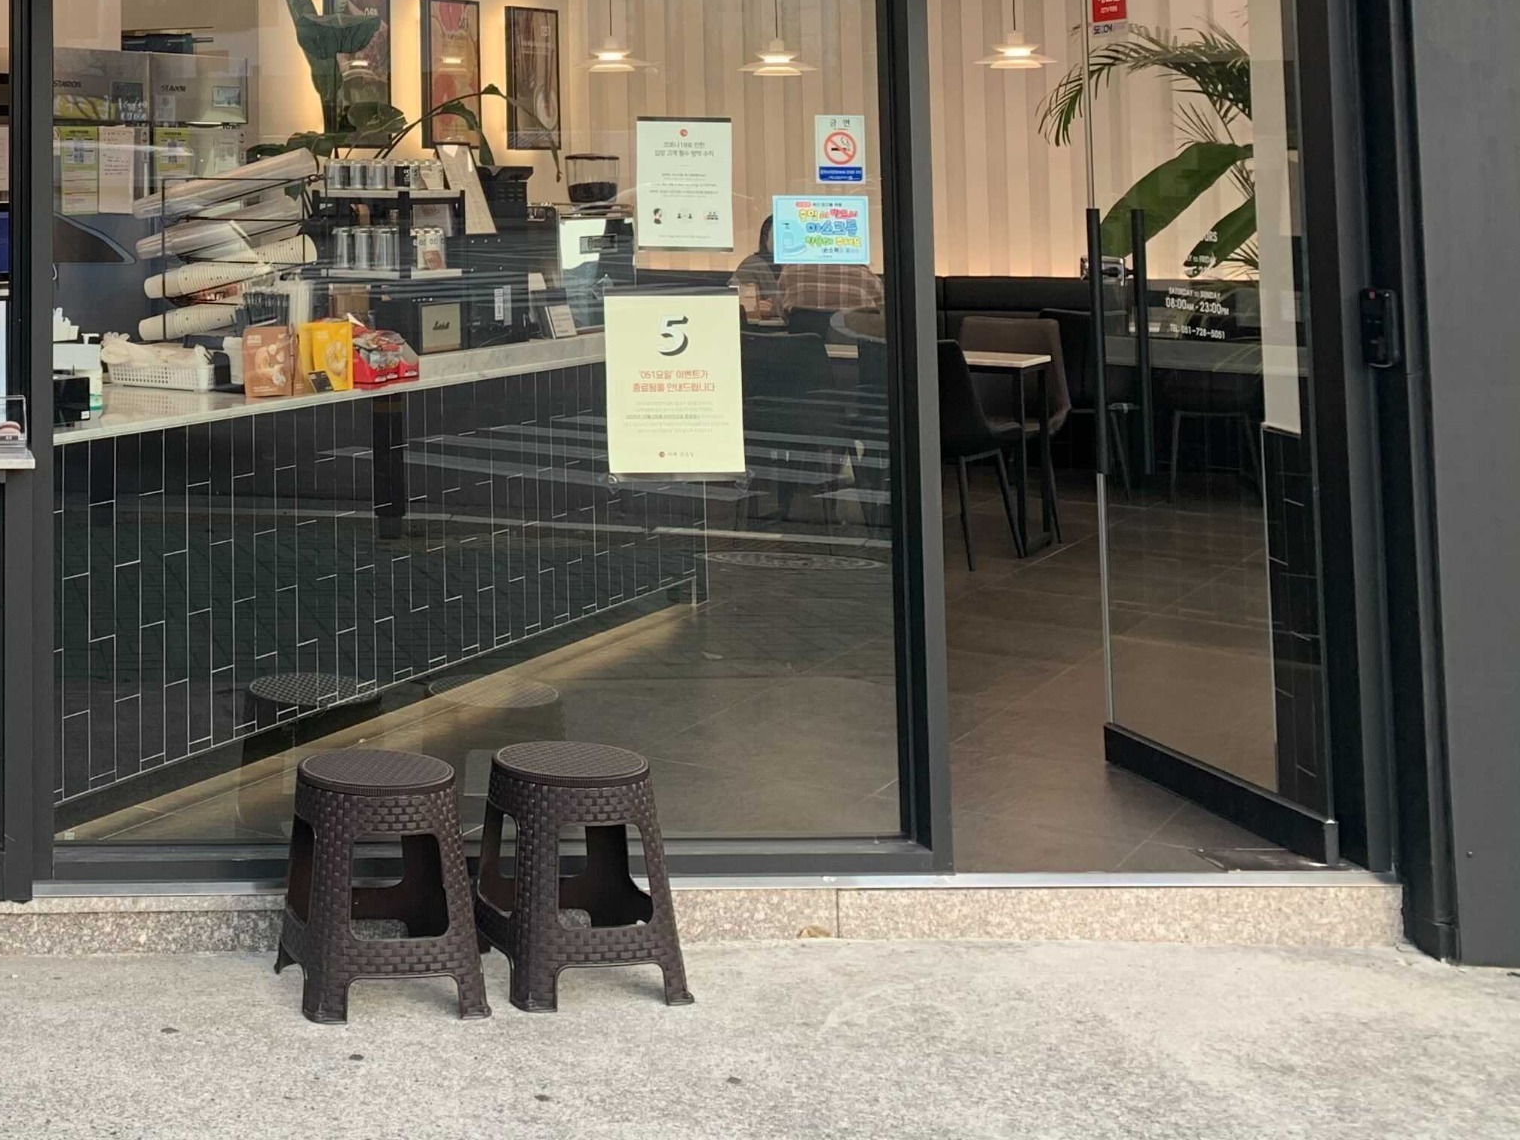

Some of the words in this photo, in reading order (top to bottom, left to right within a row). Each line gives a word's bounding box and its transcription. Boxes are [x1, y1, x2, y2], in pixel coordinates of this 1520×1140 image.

[805, 219, 857, 237] 마스크를
[1168, 287, 1193, 296] SATURDAY
[1200, 290, 1221, 299] SUNDAY
[1200, 301, 1229, 315] 23:00PM
[676, 369, 708, 380] 이벤트가
[633, 382, 665, 393] 종료됨을
[667, 382, 716, 393] 안내드립니다
